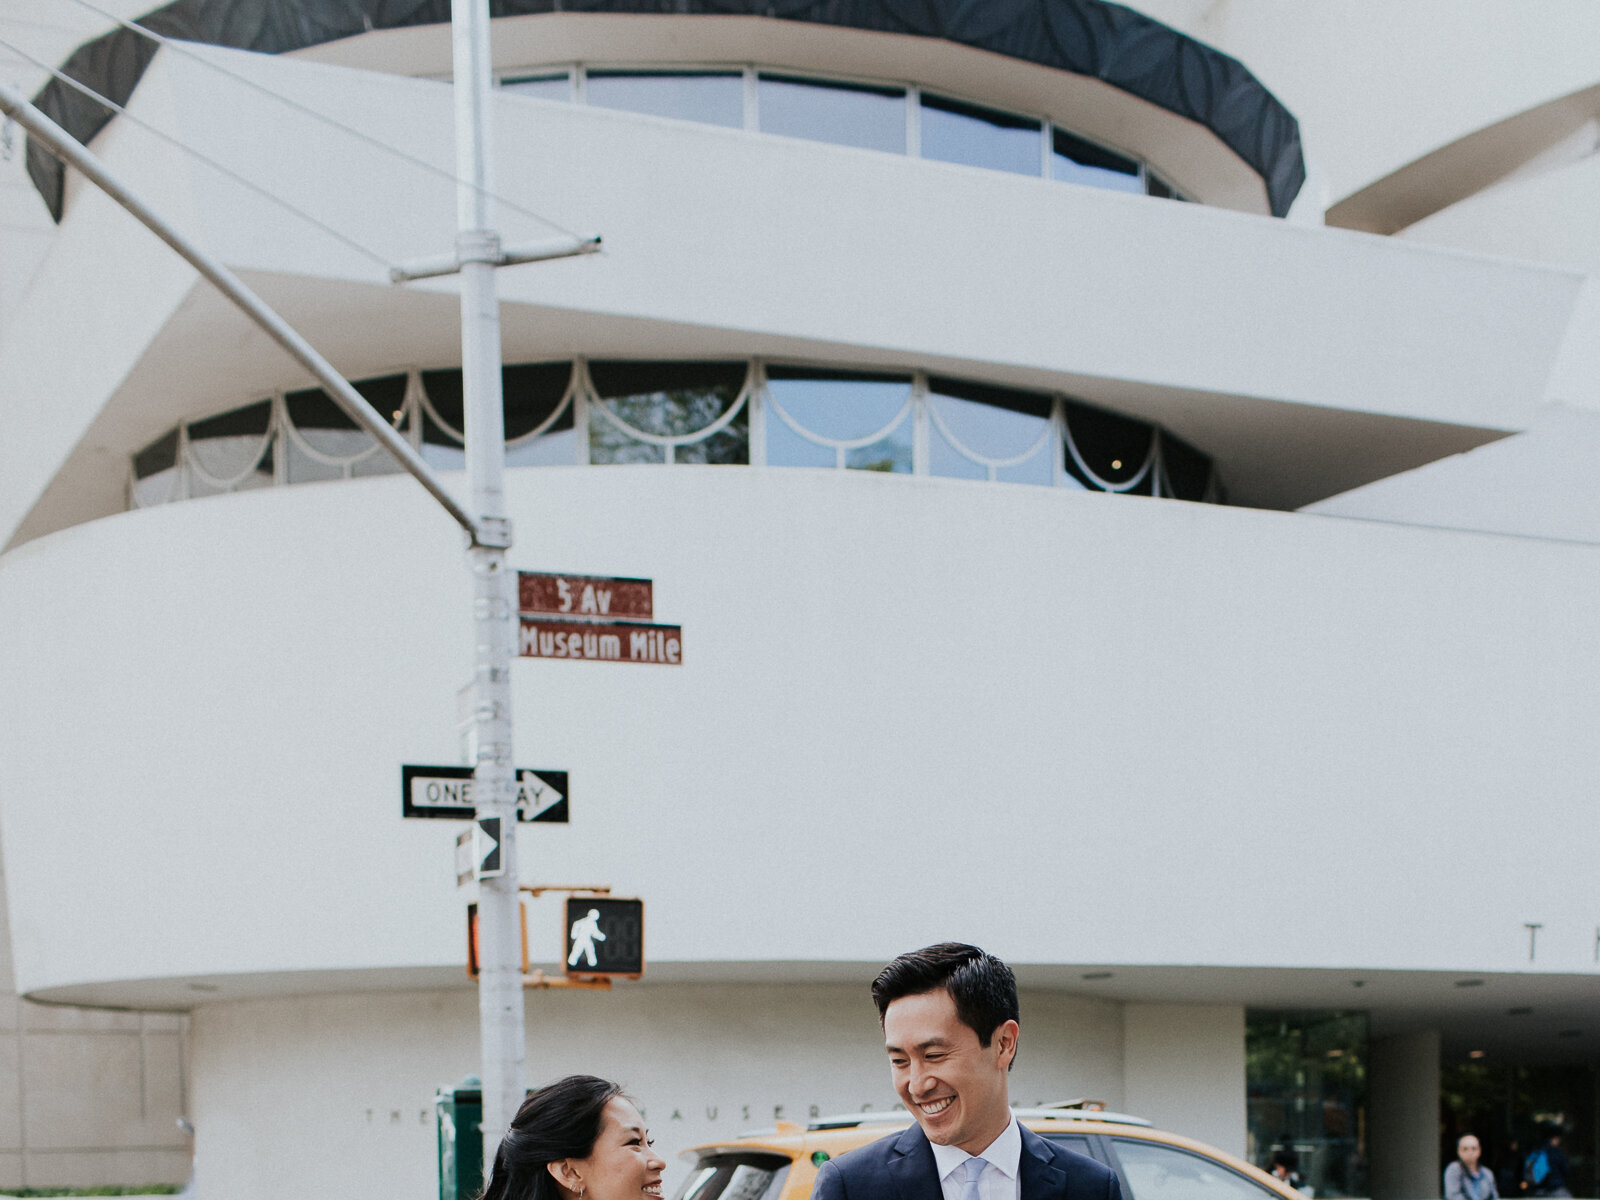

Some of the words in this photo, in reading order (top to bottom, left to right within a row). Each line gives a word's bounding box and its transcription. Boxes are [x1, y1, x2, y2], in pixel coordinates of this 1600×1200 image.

[556, 578, 573, 613] 5
[520, 625, 621, 660] Museum
[630, 630, 680, 663] Mile
[426, 782, 473, 804] ONE
